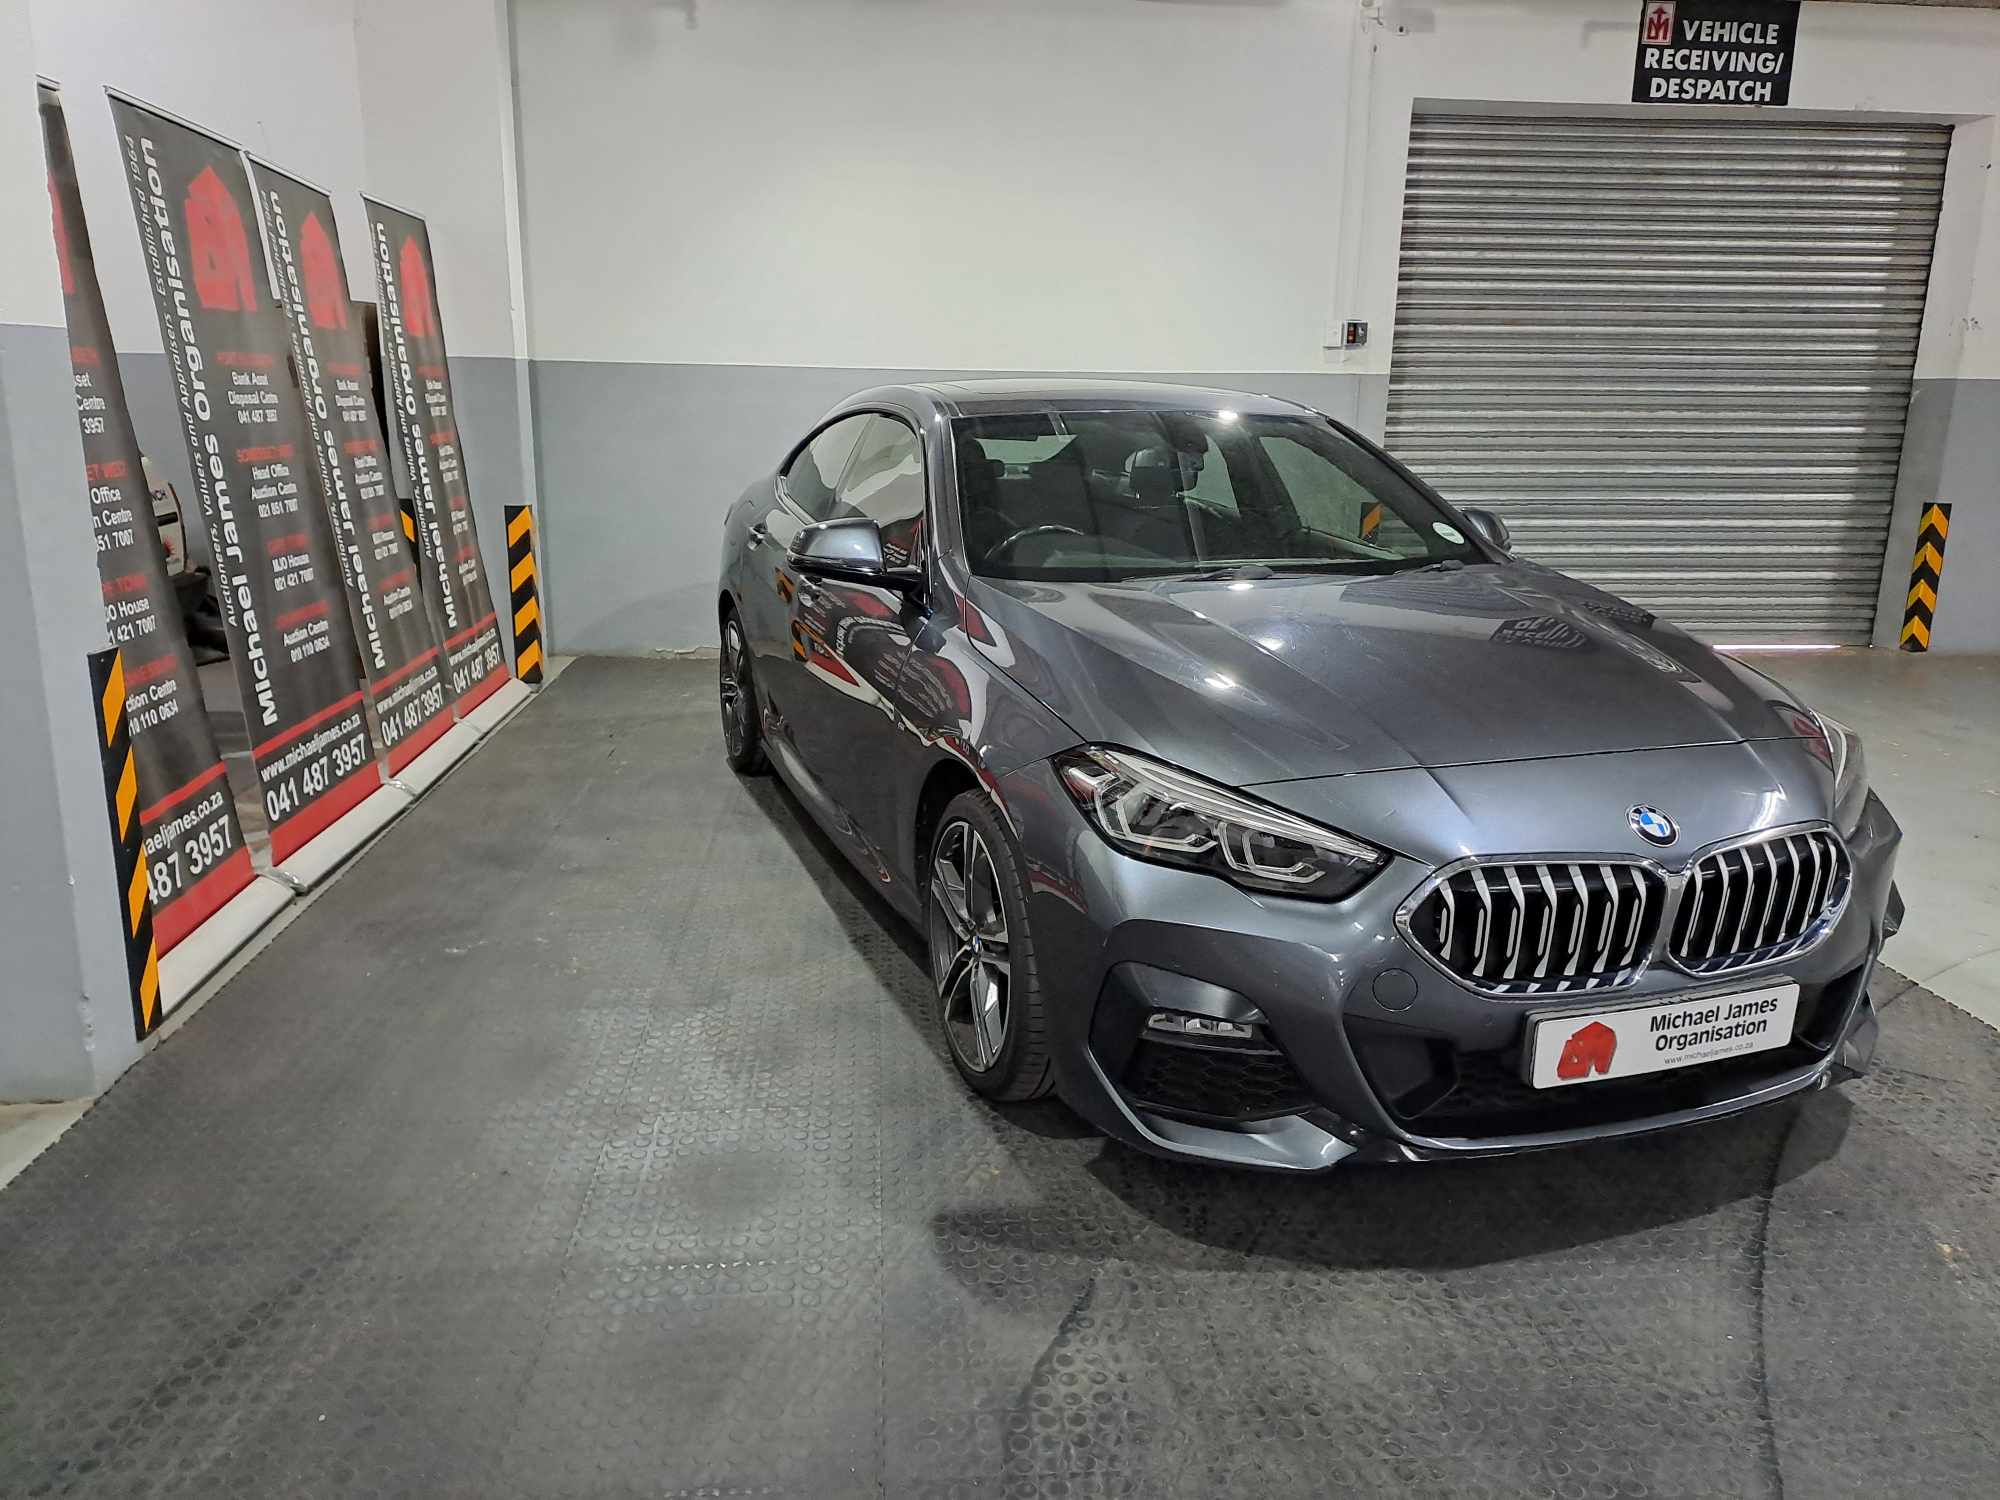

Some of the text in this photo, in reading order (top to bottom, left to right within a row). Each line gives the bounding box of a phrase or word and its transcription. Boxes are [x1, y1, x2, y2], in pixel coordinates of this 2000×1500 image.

[1643, 47, 1785, 75] RECEIVING/
[1682, 19, 1780, 45] VEHICLE
[1649, 77, 1773, 102] DESPATCH
[135, 187, 166, 296] Established
[270, 191, 328, 420] Organisation
[376, 222, 417, 416] Organisation
[164, 313, 191, 409] Appraisers
[140, 136, 278, 727] Michael James Organisation
[184, 411, 199, 447] and
[91, 486, 122, 504] Office
[193, 451, 214, 516] Valuers
[323, 429, 355, 536] James
[411, 423, 437, 515] James
[102, 508, 132, 526] Centre
[210, 522, 238, 627] Auctioneers,
[428, 521, 458, 628] Michael
[117, 598, 150, 618] House
[117, 622, 135, 642] 421
[347, 544, 386, 670] Michael
[126, 680, 177, 712] ction Centre
[453, 664, 471, 694] 041
[471, 654, 484, 680] 487
[140, 709, 158, 729] 110
[381, 682, 443, 746] 041 487 3957
[260, 713, 361, 783] www.michaeljames.co.za
[266, 733, 366, 821] 041 487 3957
[184, 814, 232, 875] 3957
[1650, 998, 1778, 1032] Michael James
[1655, 1019, 1768, 1051] Organisation
